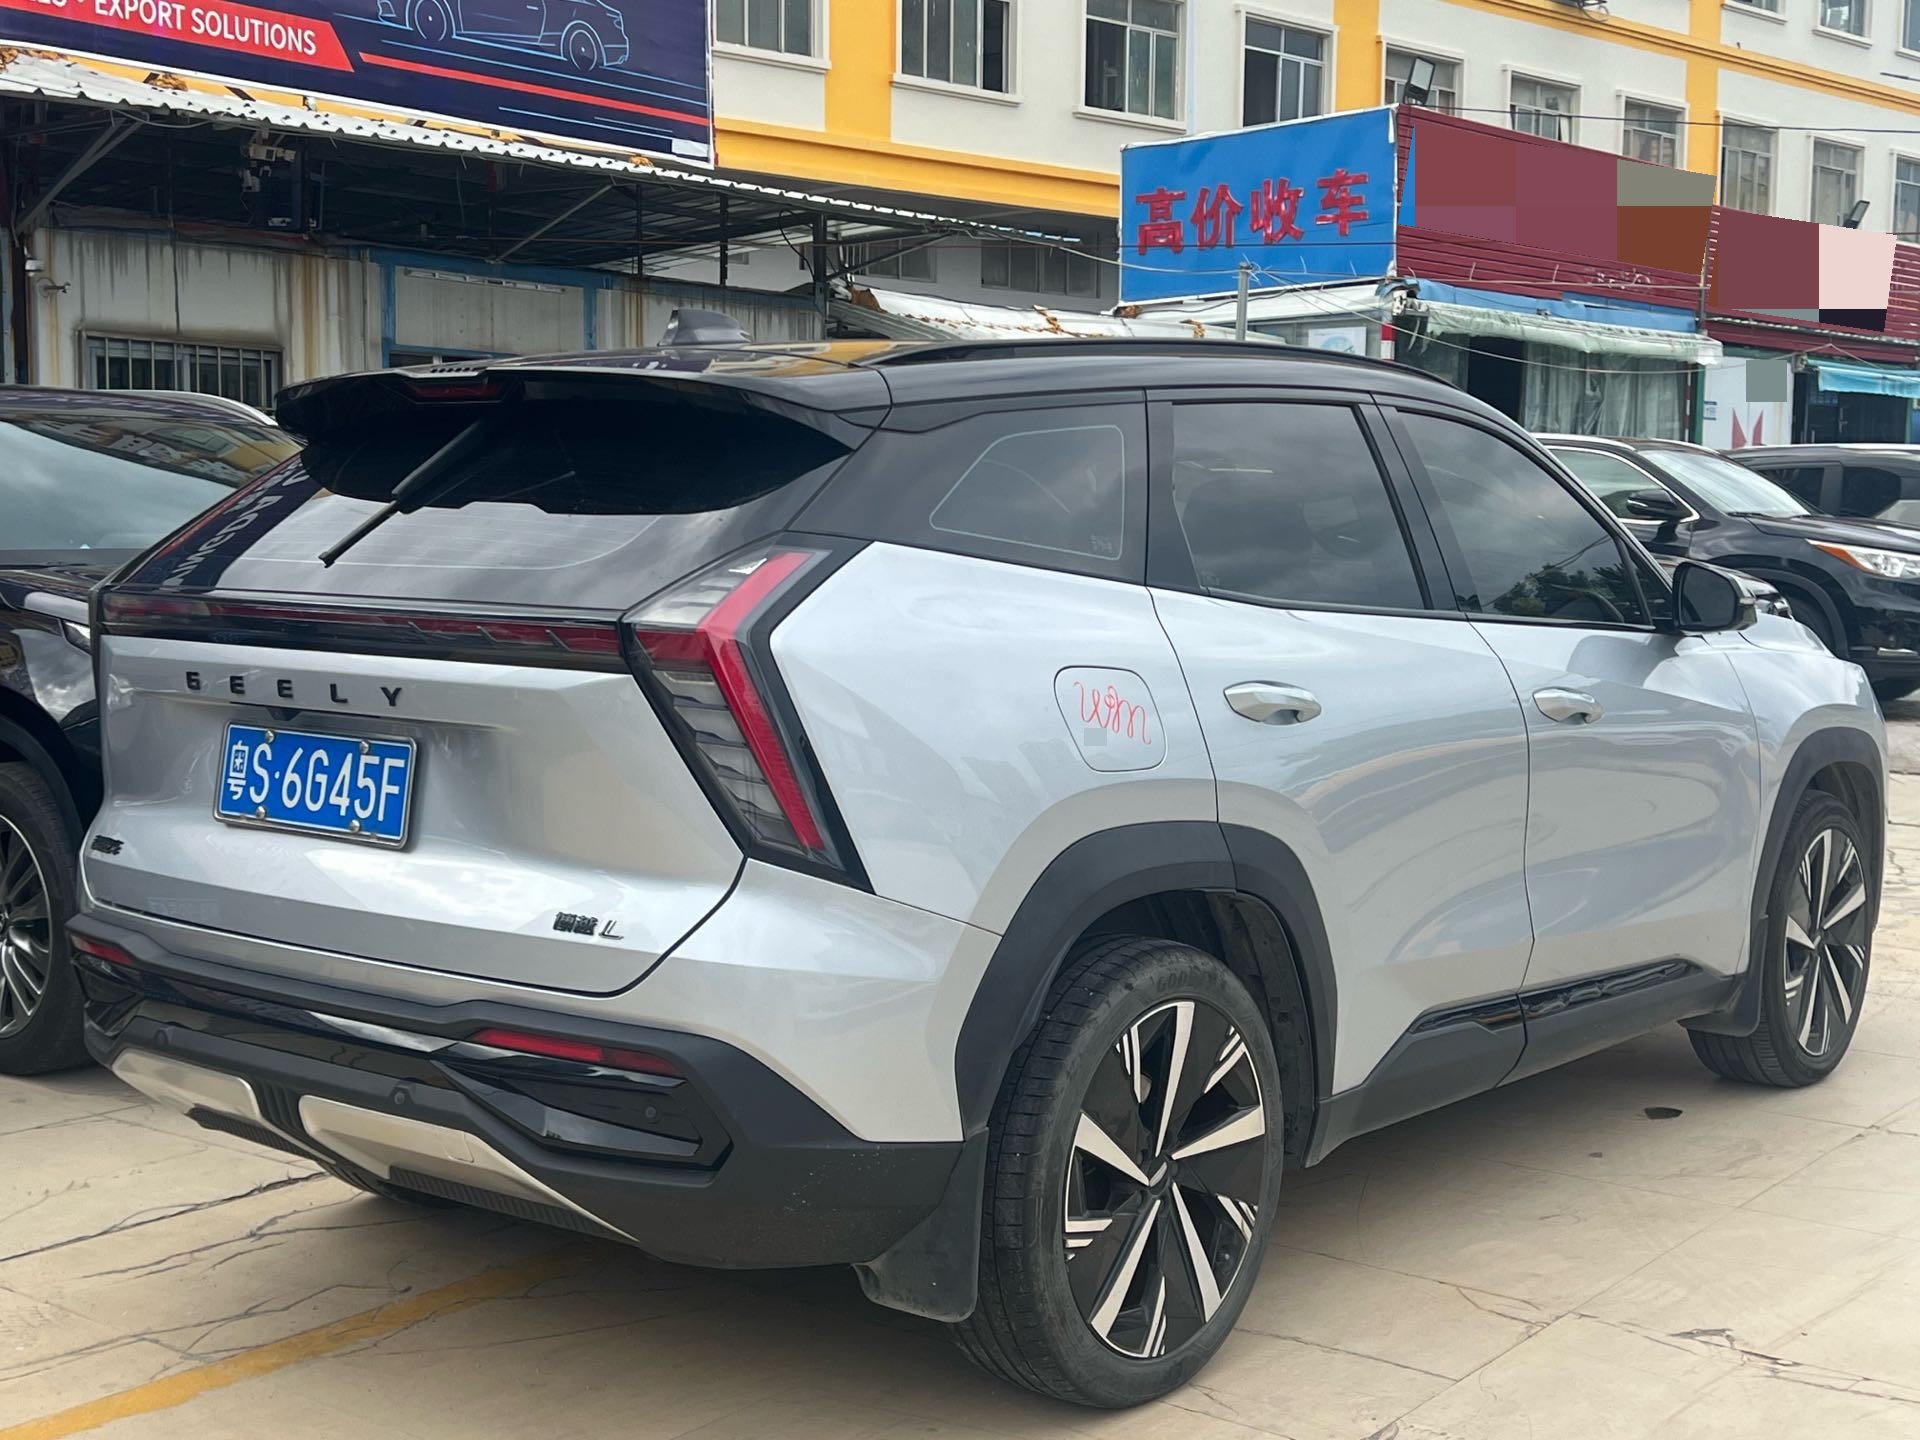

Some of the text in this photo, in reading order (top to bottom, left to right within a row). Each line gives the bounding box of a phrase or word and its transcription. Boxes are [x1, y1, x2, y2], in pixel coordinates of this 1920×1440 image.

[95, 0, 317, 55] EXPORT SOLUTIONS
[1135, 167, 1370, 256] 高价收车
[185, 671, 403, 708] GEELY
